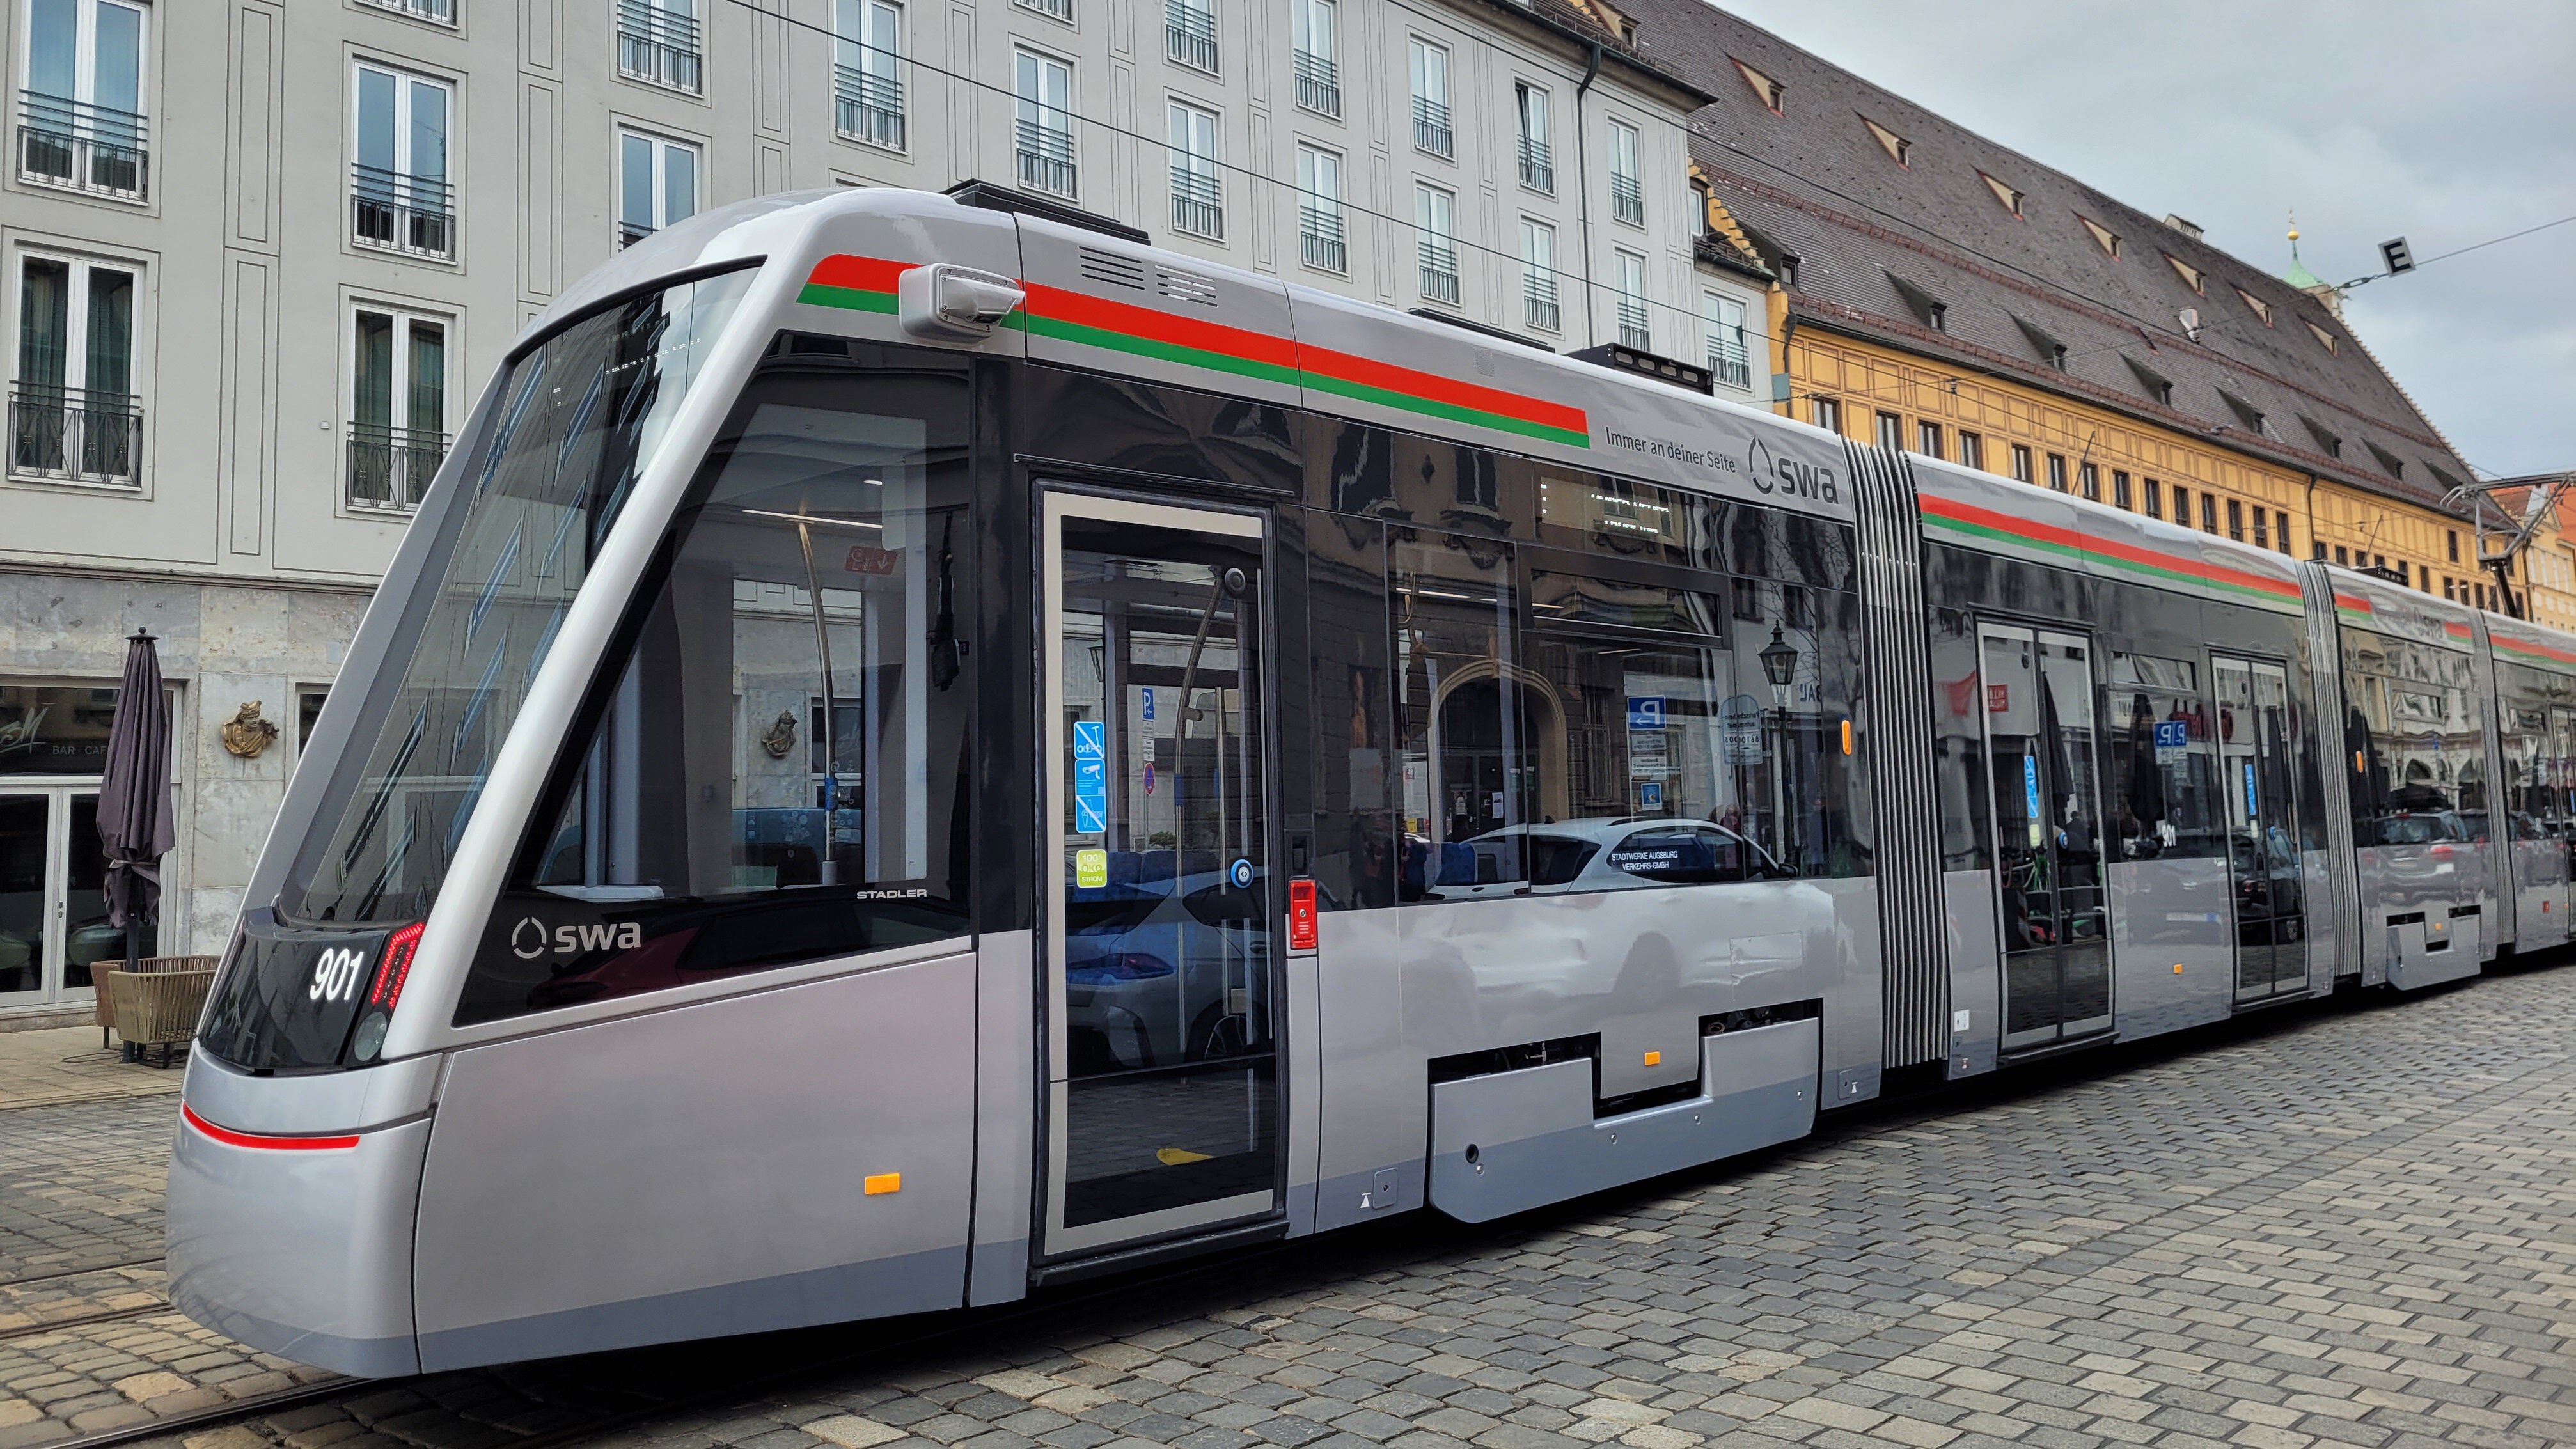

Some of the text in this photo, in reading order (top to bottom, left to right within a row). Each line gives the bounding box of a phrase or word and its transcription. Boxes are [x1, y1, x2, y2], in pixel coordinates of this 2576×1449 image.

[2383, 241, 2411, 273] E
[1605, 426, 1736, 473] Immer an deiner Seite
[1778, 458, 1839, 504] swa
[52, 746, 75, 755] BAR
[85, 746, 107, 755] CAF
[2162, 824, 2176, 847] 901
[1612, 851, 1678, 861] STADTWERKE AUGSBURG
[1622, 861, 1669, 870] VERKEHRS-GMBH
[856, 889, 927, 899] STADLER
[554, 921, 641, 953] swa
[310, 948, 365, 1001] 901
